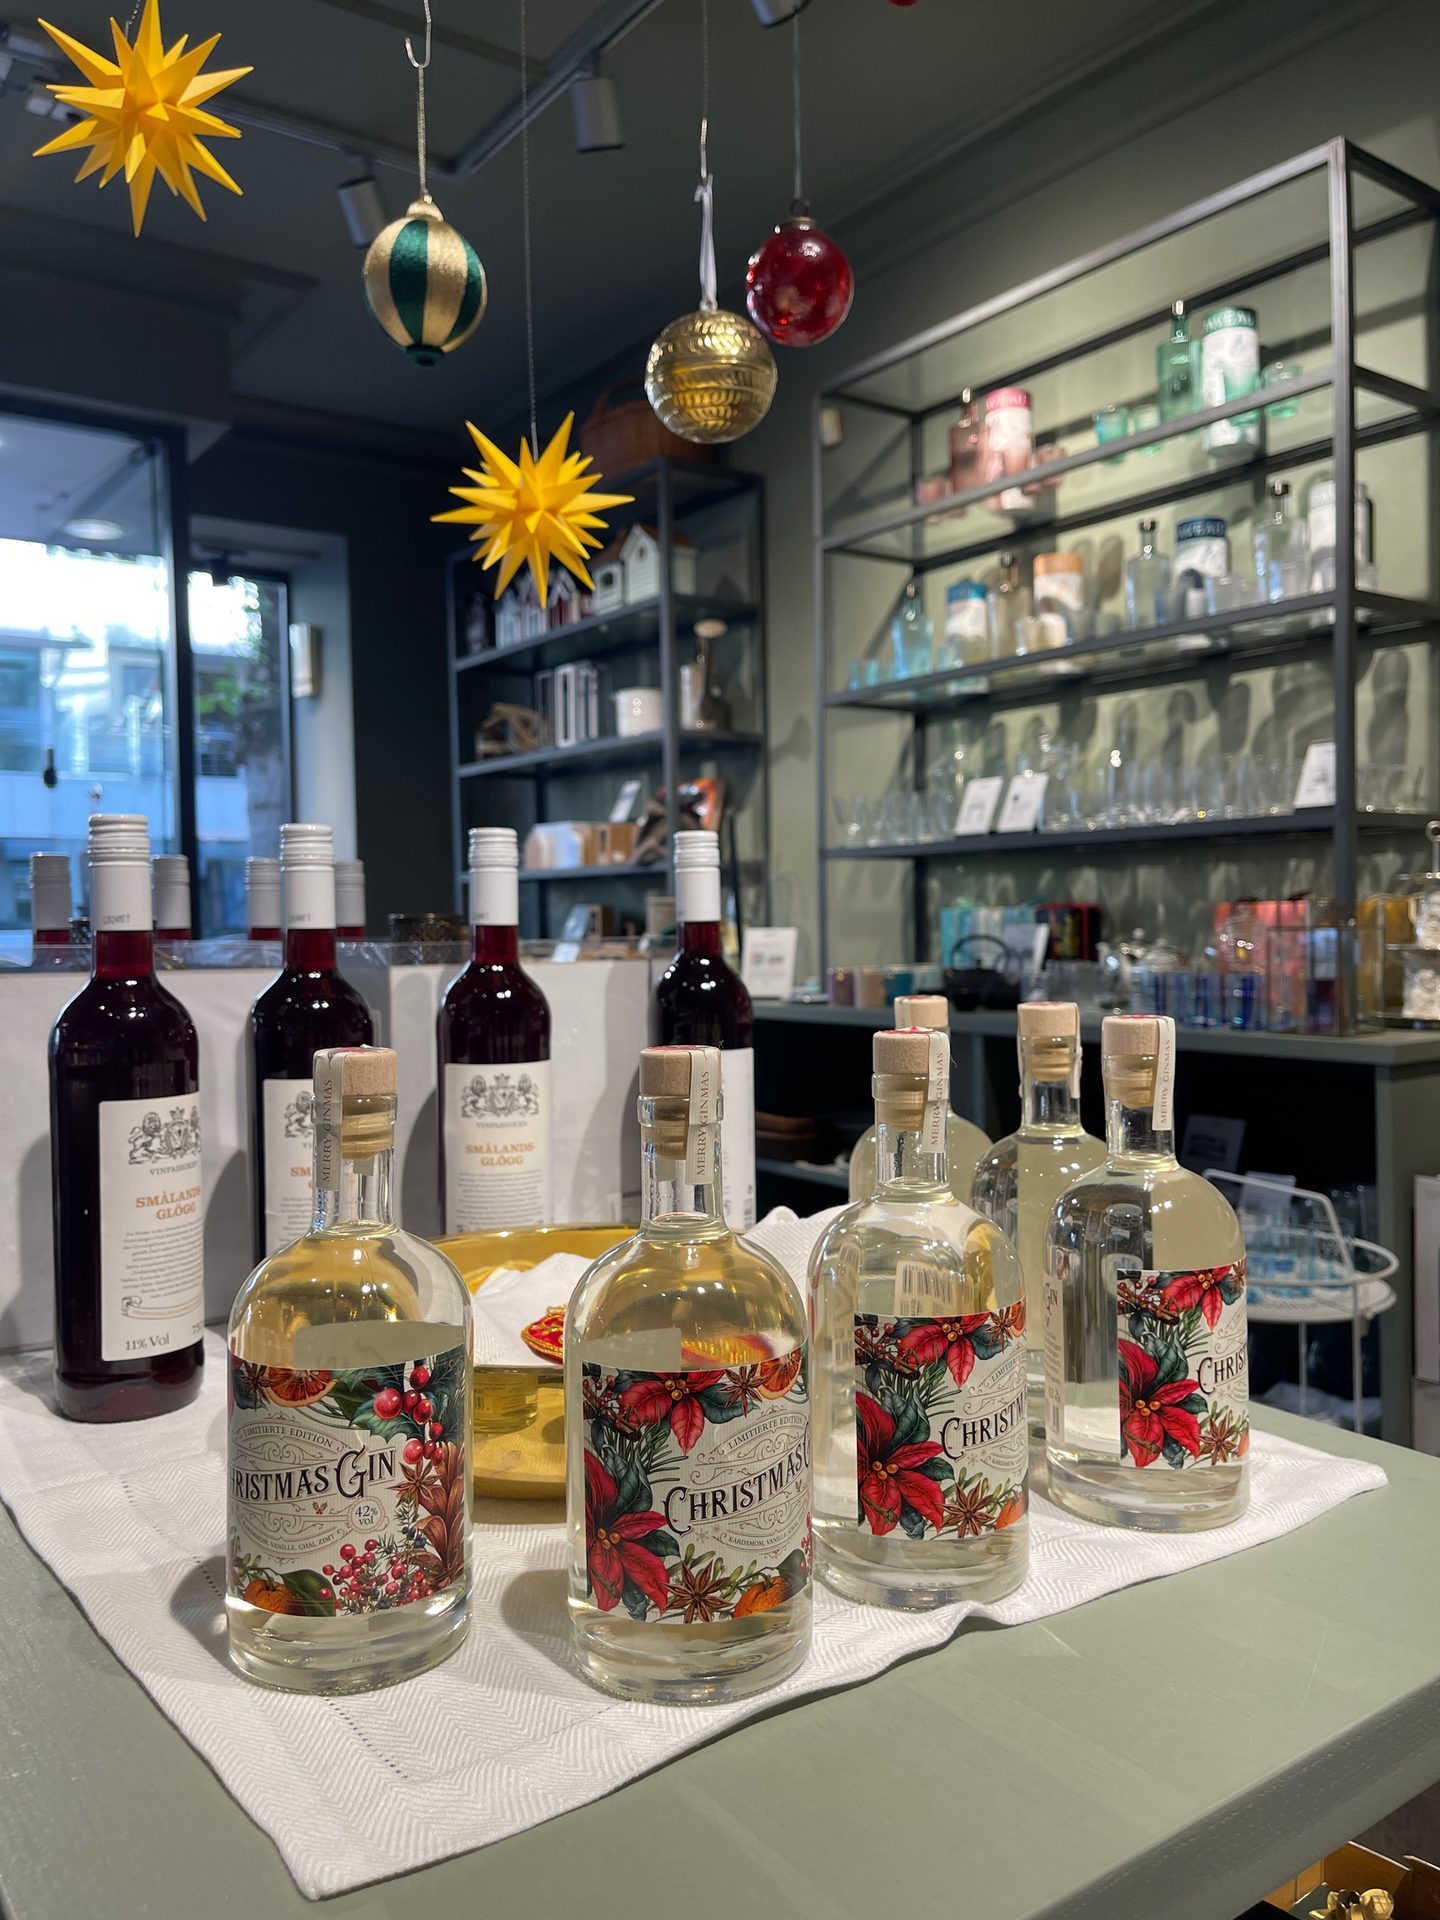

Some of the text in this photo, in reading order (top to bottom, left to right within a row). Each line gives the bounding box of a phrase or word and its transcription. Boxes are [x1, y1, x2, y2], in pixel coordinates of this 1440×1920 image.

[1163, 1039, 1171, 1083] GINMAS
[931, 1052, 944, 1146] MERRY GINMAS
[322, 1079, 333, 1183] MERRY GINMAS
[696, 1071, 709, 1175] MERRY GINMAS
[480, 1154, 524, 1167] GLÖGG
[156, 1201, 197, 1221] GLÖGG
[125, 1333, 170, 1351] 11% Vol
[243, 1425, 334, 1448] LIMITIERTE EDITION
[728, 1420, 778, 1450] LIMITIERTE
[334, 1444, 395, 1498] GIN
[662, 1442, 803, 1536] CHRISTMAS
[355, 1505, 378, 1518] 42%
[359, 1515, 374, 1526] vol
[319, 1533, 335, 1545] ZIMT
